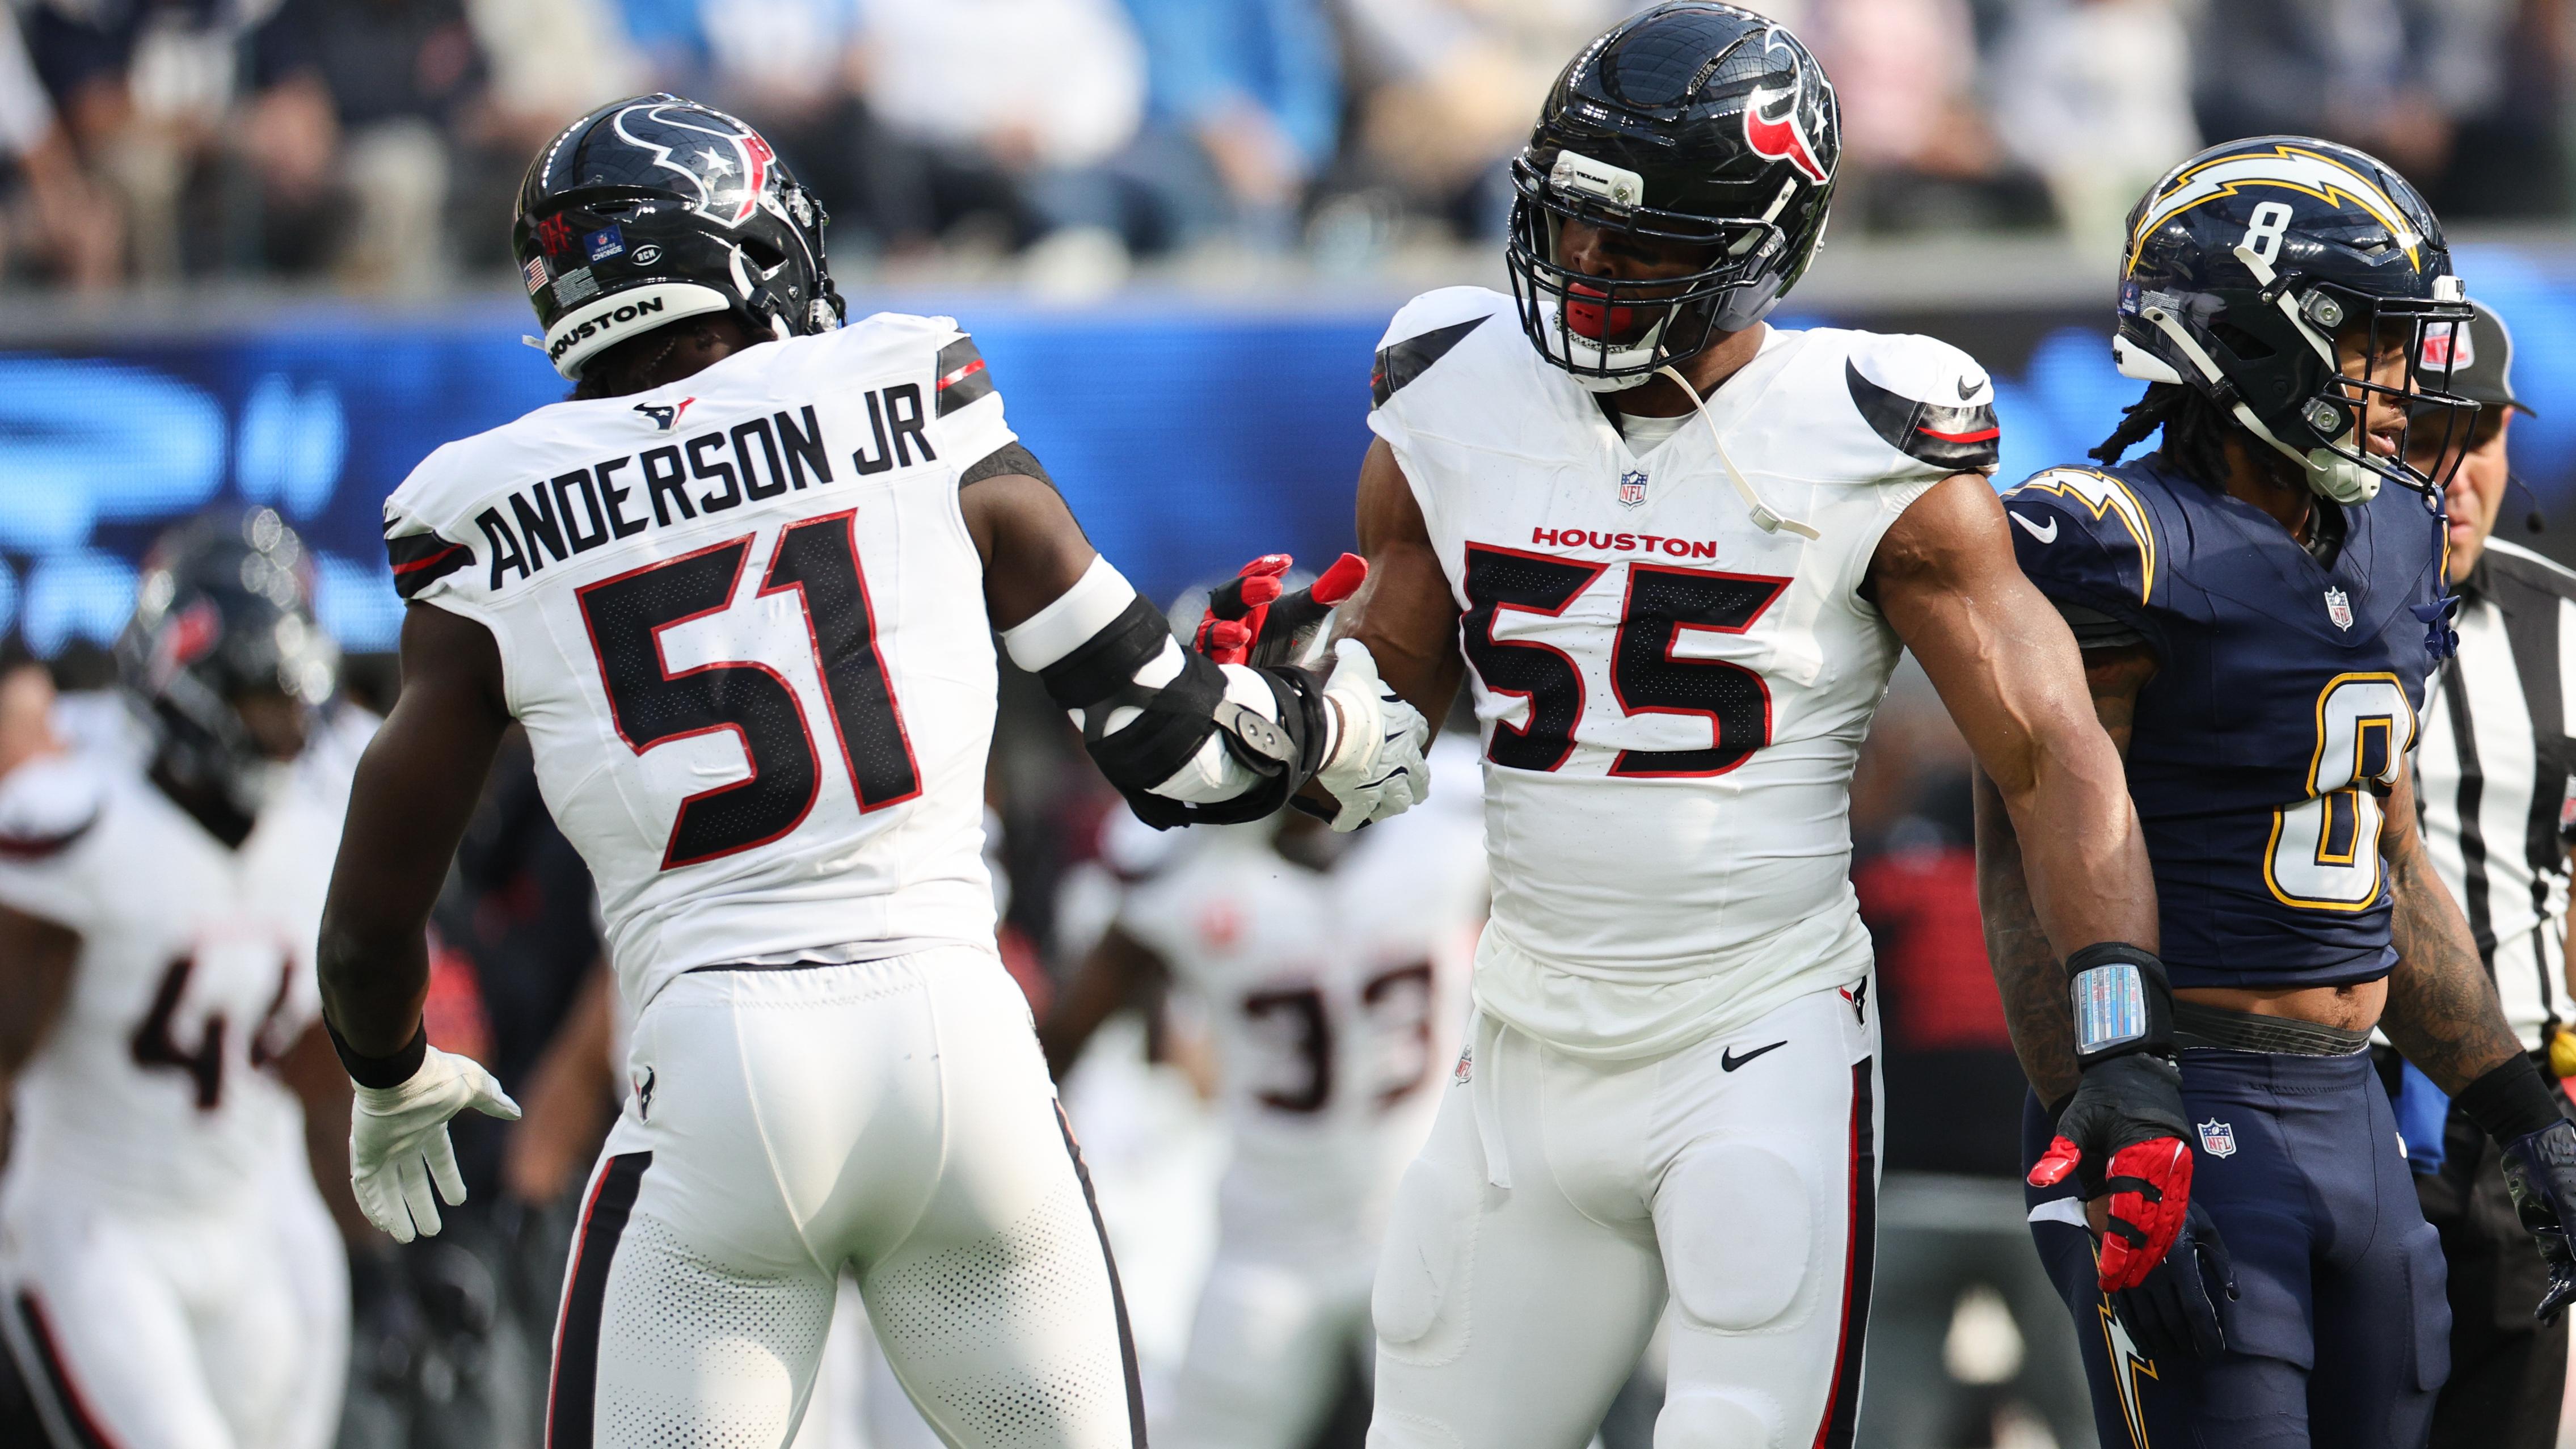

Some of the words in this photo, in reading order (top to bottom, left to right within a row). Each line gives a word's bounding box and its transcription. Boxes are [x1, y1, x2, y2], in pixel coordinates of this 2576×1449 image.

[2241, 201, 2293, 266] 8
[592, 245, 623, 262] CHANGE
[547, 296, 664, 365] HOUSTON
[2423, 336, 2467, 365] NFL
[475, 405, 833, 591] ANDERSON
[853, 383, 938, 476] JR
[1621, 485, 1643, 502] NFL
[1532, 526, 1717, 558] HOUSTON
[2333, 607, 2351, 624] NFL
[1460, 540, 1794, 777] 55
[574, 507, 924, 871] 51
[2263, 672, 2416, 911] 8
[1457, 1059, 1472, 1077] NFL
[2207, 1137, 2231, 1152] NFL
